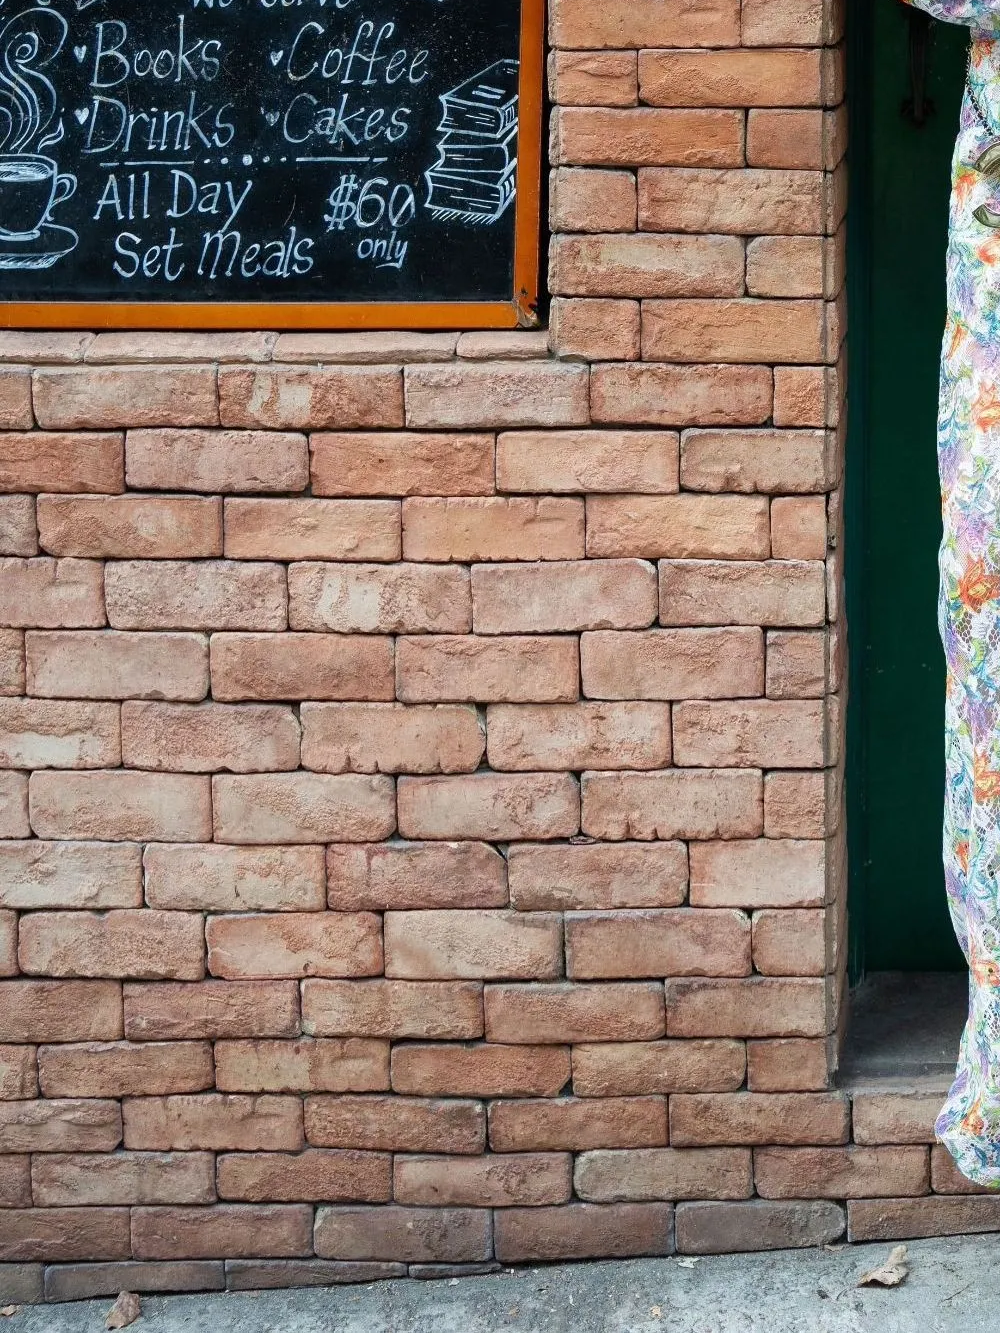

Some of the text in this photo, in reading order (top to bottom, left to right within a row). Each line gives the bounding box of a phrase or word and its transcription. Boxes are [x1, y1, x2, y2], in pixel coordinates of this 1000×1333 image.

[90, 15, 430, 88] Books Coffee
[80, 90, 412, 154] Drinks Cakes
[93, 169, 253, 235] All Day
[323, 174, 416, 233] $60
[112, 227, 186, 282] Set
[356, 230, 409, 269] only
